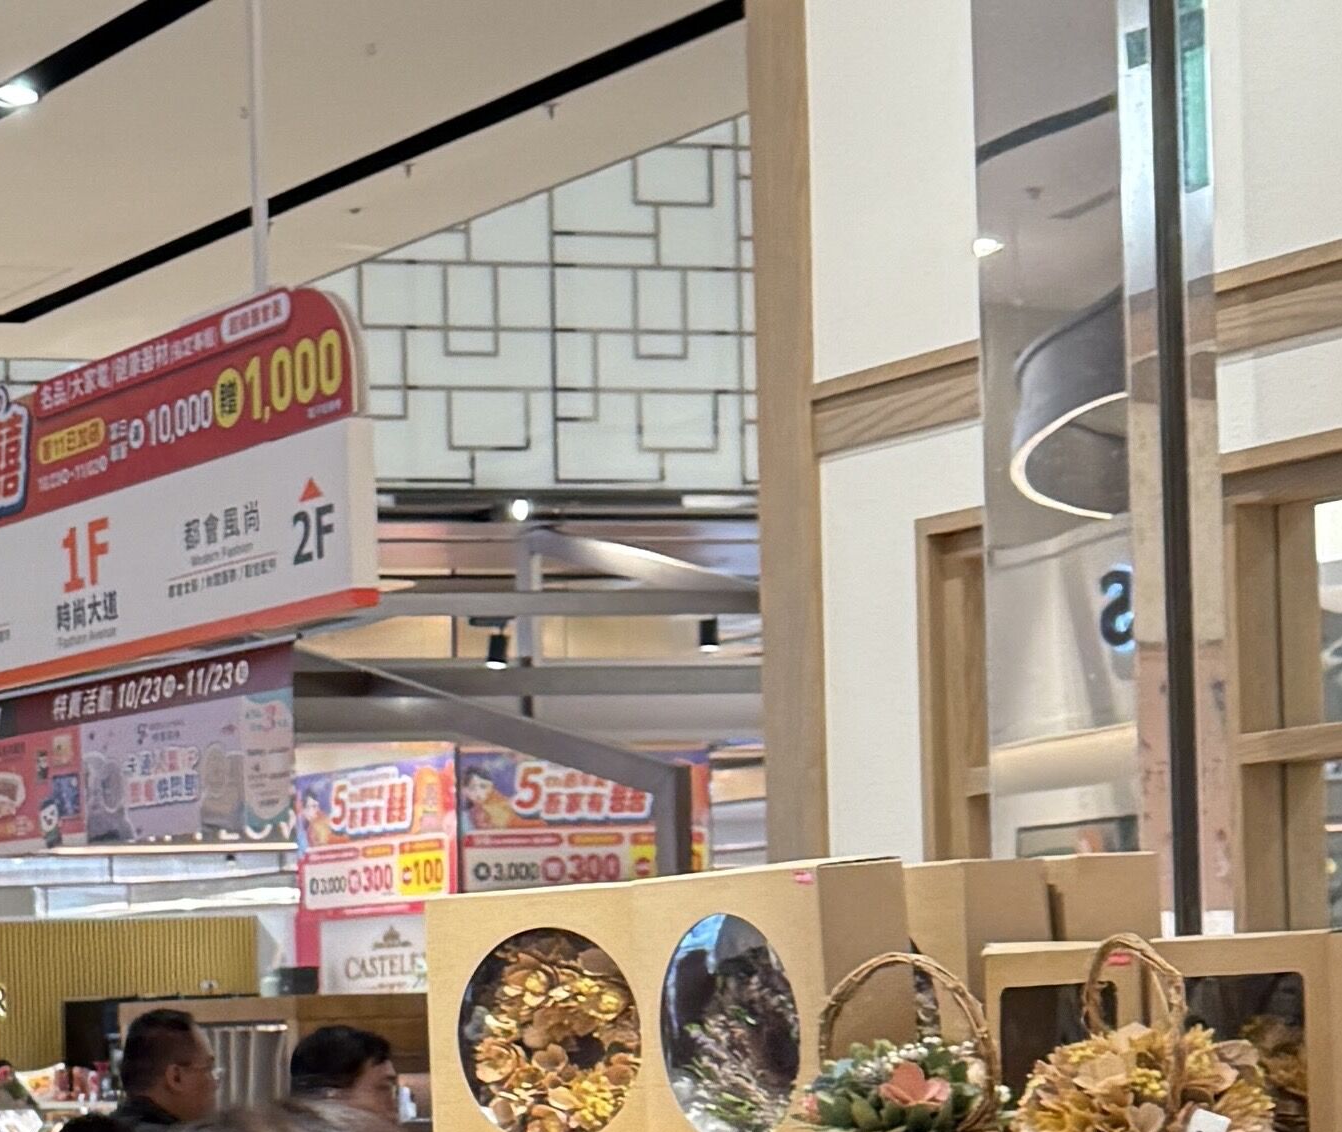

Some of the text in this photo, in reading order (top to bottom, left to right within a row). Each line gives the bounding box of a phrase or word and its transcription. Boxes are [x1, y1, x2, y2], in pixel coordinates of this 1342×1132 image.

[146, 389, 214, 446] 10,000
[245, 329, 342, 423] 1,000
[184, 500, 260, 551] 都會風尚
[293, 503, 334, 566] 2F
[63, 517, 109, 593] 1F
[56, 590, 118, 631] 時尚大道
[363, 864, 392, 892] 300
[414, 858, 443, 886] 100
[569, 853, 621, 881] 300
